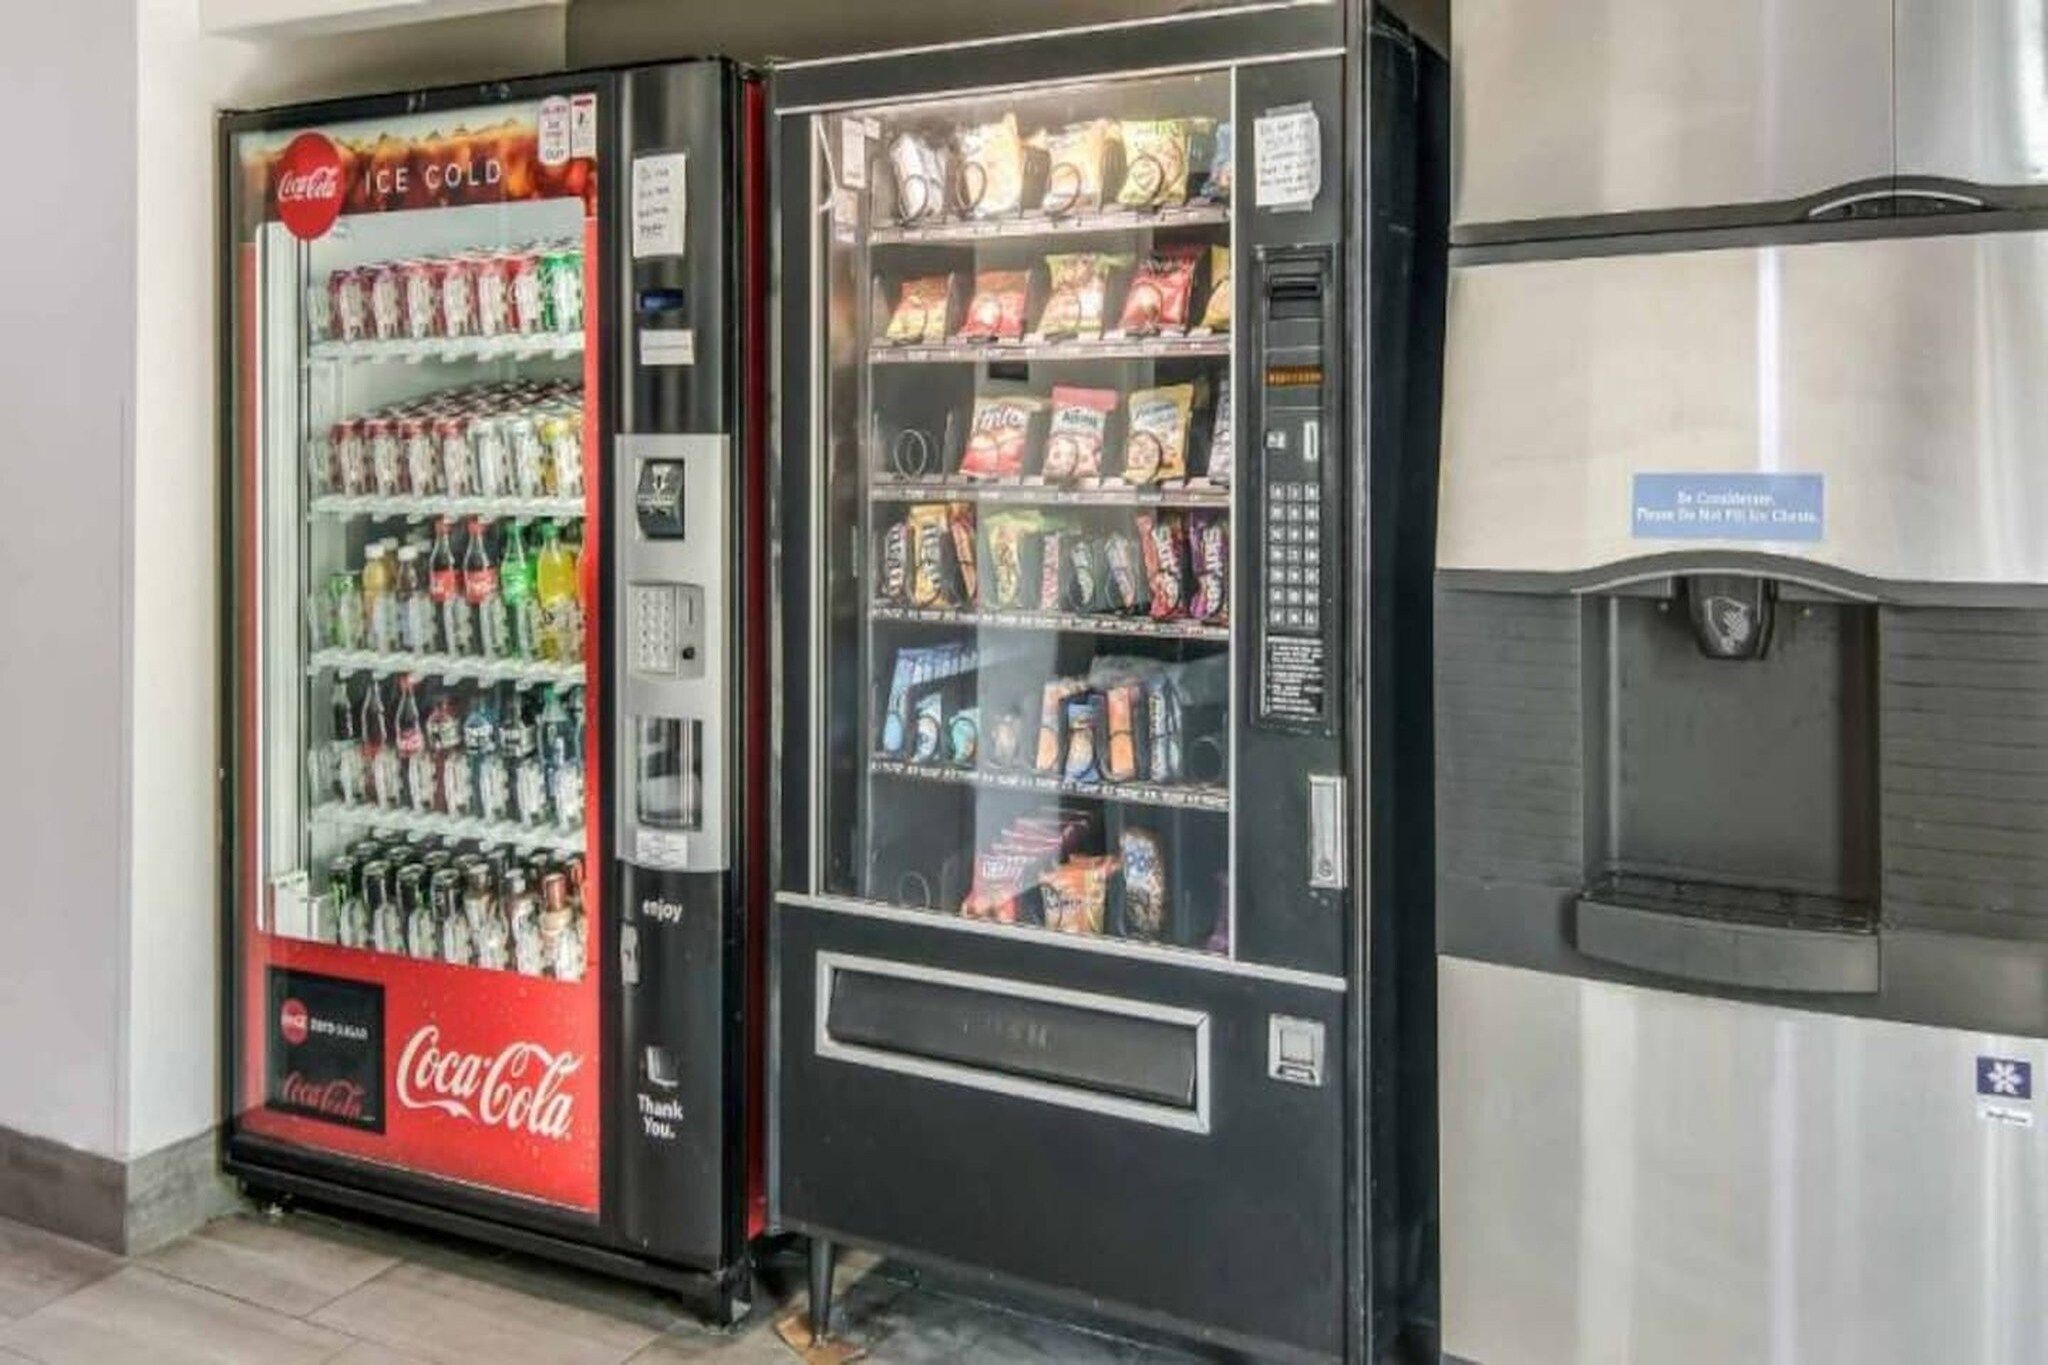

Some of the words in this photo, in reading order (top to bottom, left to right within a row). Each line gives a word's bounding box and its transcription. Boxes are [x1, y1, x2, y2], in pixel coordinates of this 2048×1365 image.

[364, 167, 409, 195] ICE
[424, 159, 501, 190] COLD
[643, 898, 682, 923] enjoy
[637, 1094, 683, 1120] Thank
